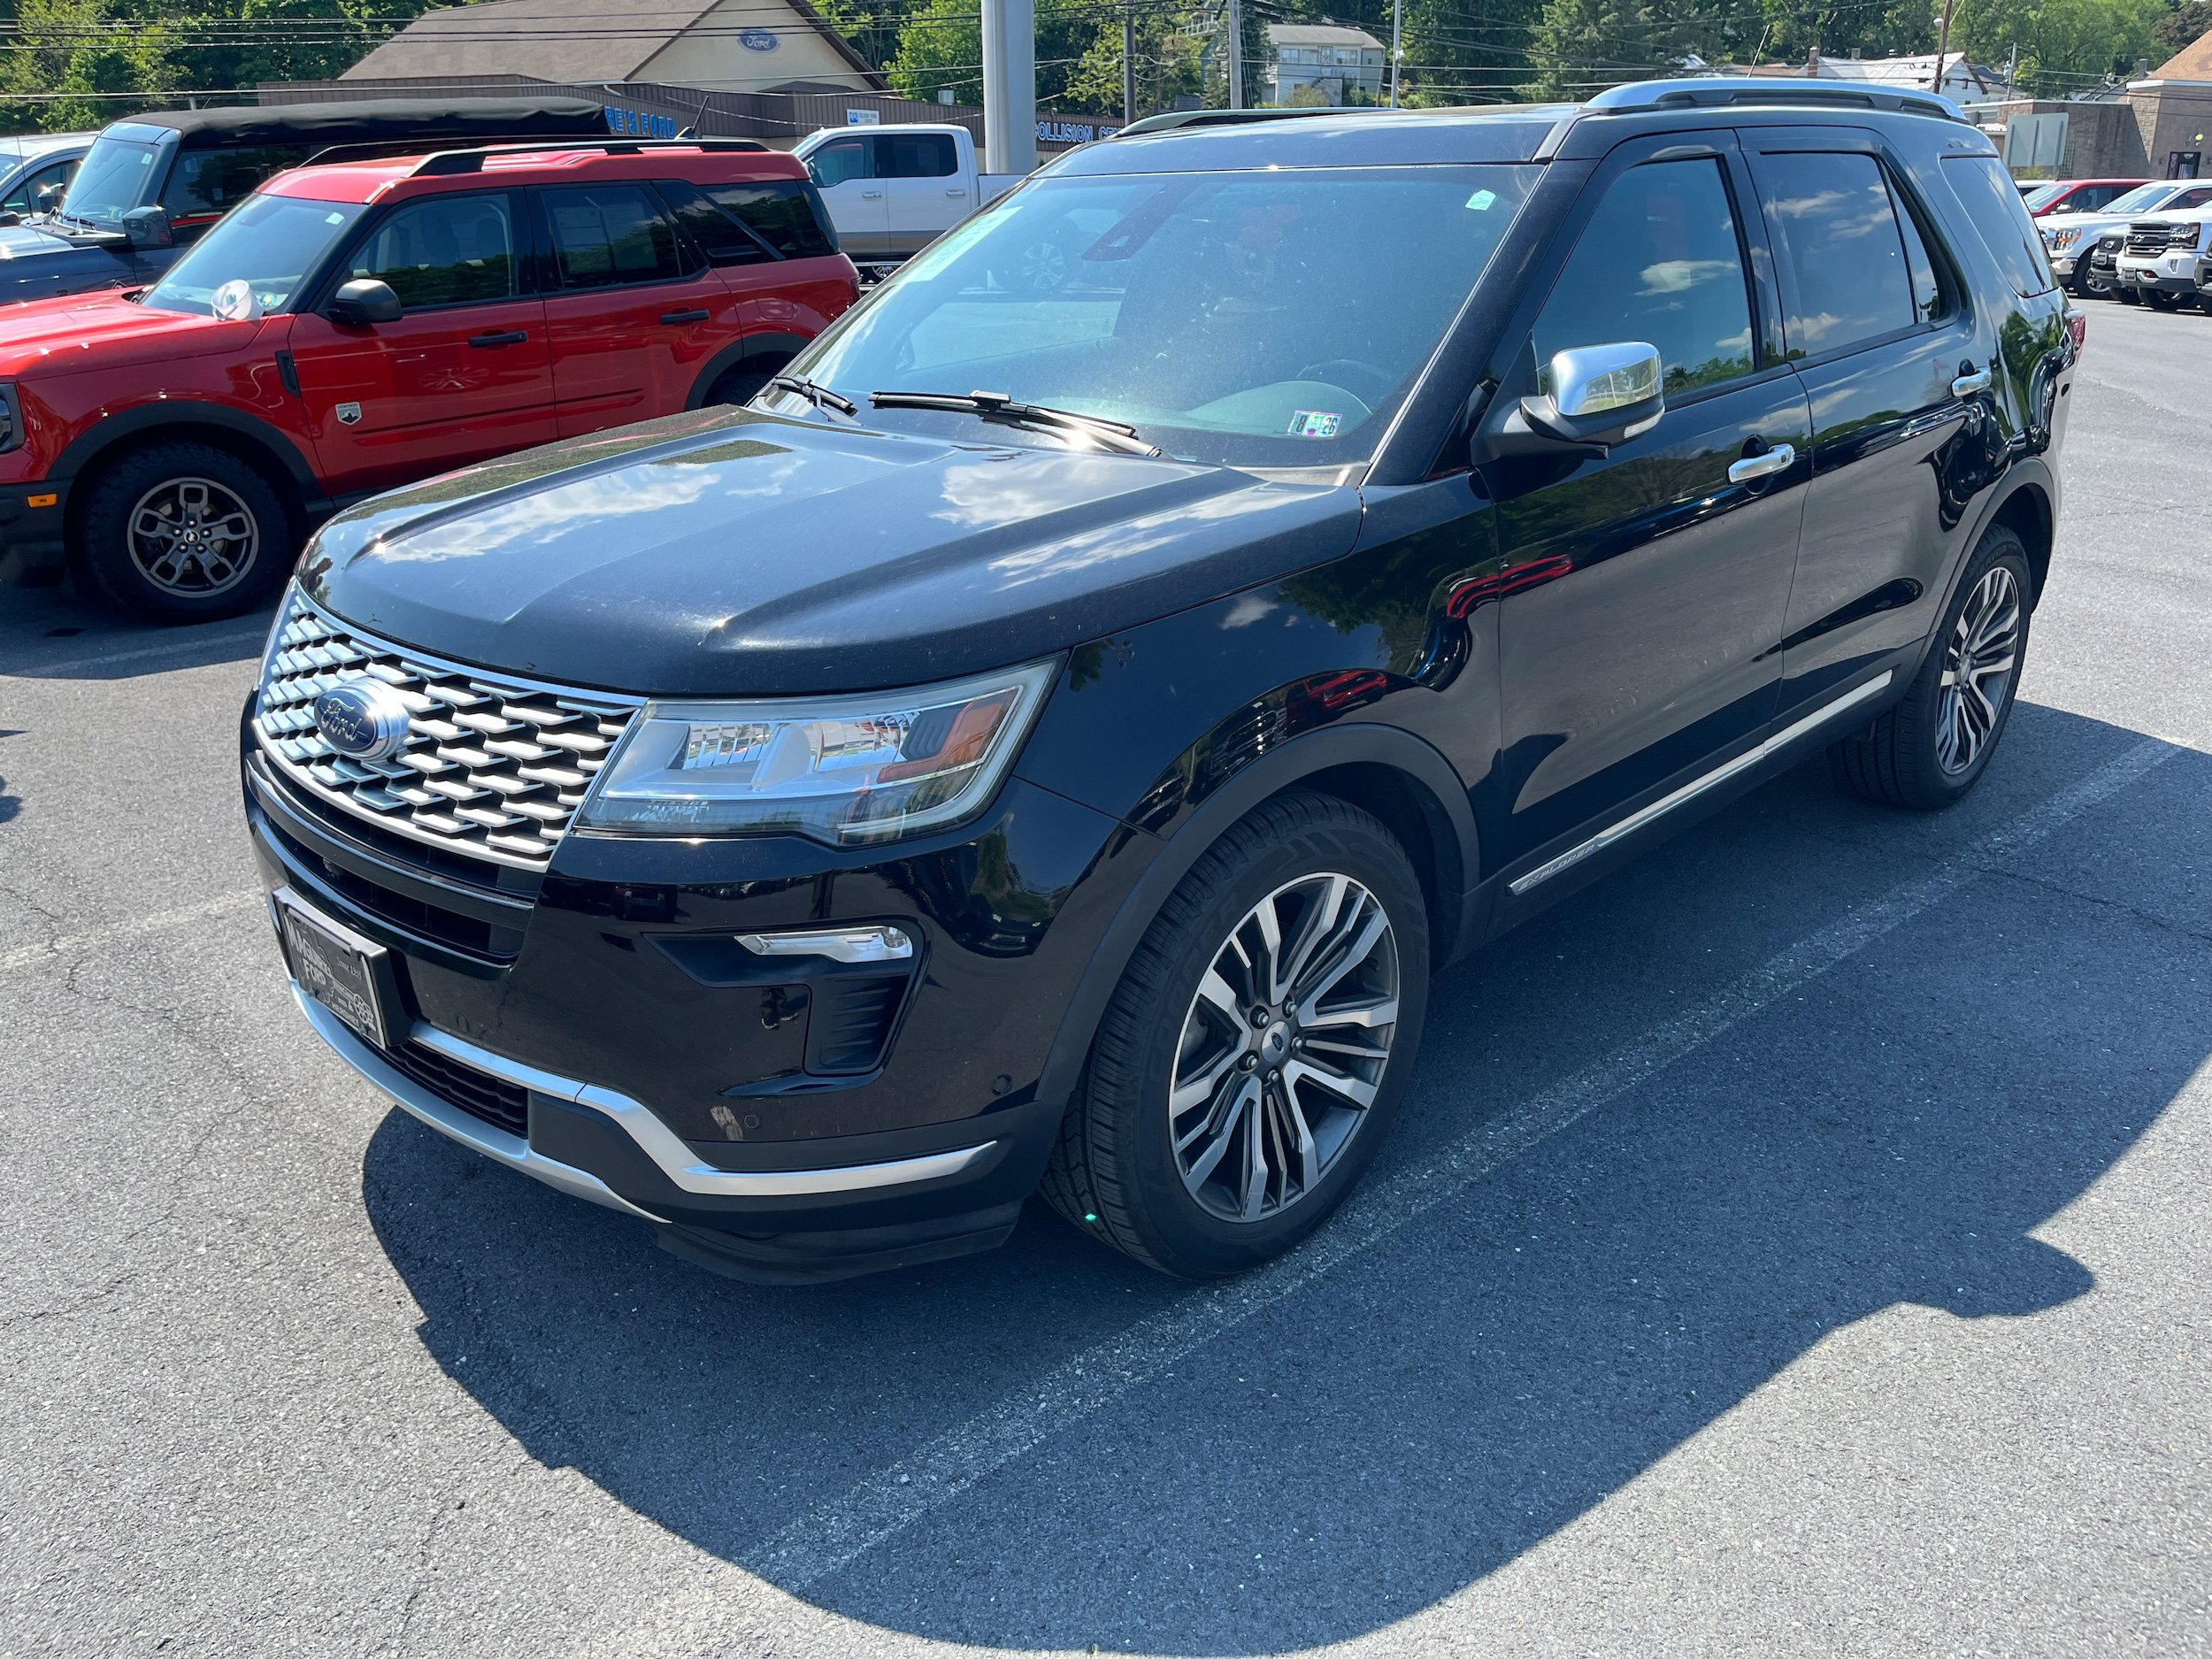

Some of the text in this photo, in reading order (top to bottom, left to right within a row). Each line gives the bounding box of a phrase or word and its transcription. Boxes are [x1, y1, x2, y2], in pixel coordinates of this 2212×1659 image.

[746, 32, 771, 49] Ford
[641, 112, 676, 138] FORD
[1035, 122, 1094, 142] OLLISION
[1321, 416, 1339, 434] 26
[320, 697, 363, 741] Ford
[1517, 843, 1596, 893] EXPLORER
